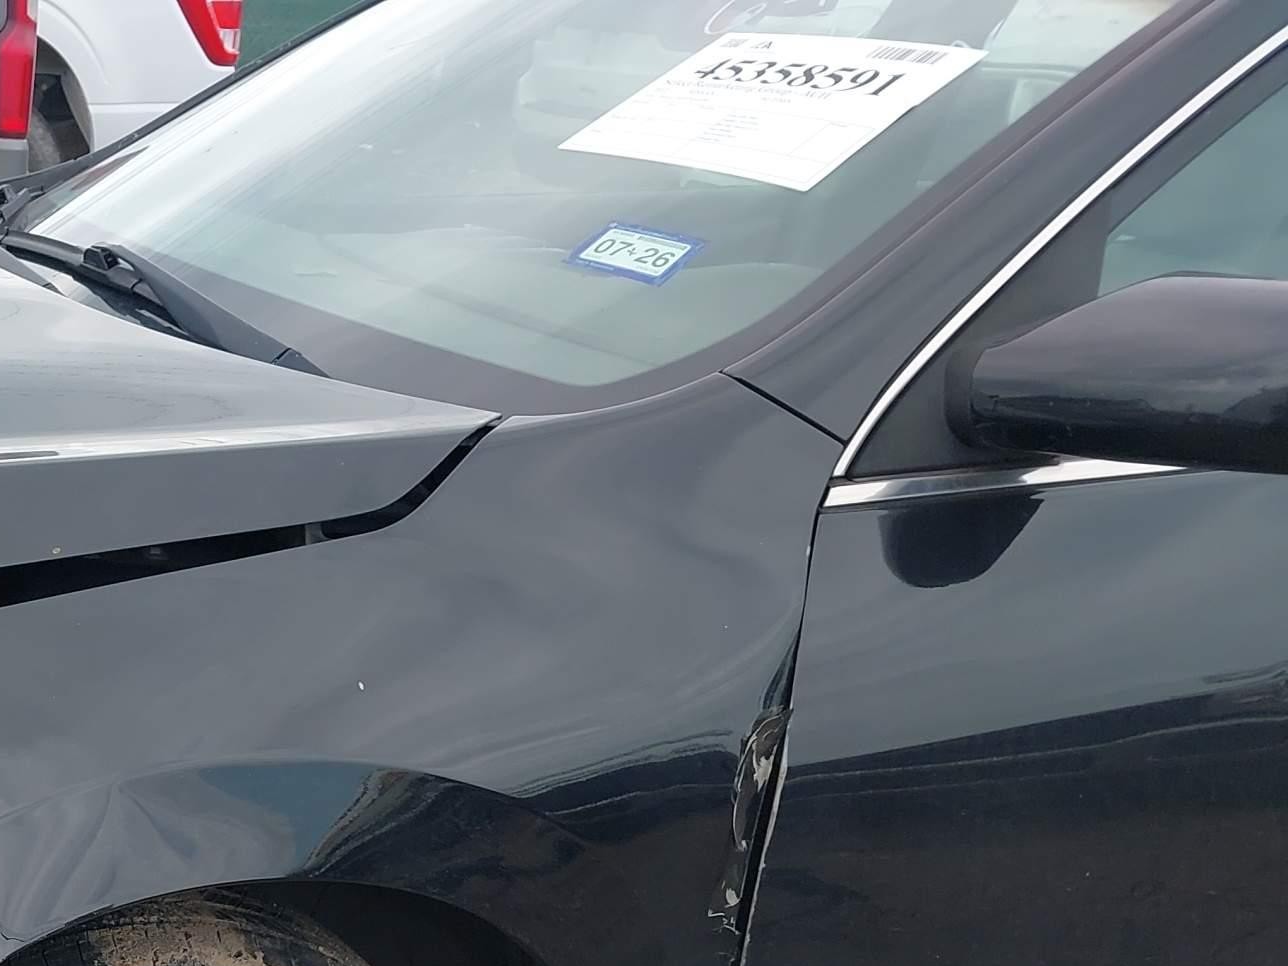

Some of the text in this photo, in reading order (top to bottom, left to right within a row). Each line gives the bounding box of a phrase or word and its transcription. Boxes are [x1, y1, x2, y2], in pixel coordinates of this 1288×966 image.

[694, 58, 906, 97] 45358591
[593, 238, 634, 257] 07
[633, 247, 676, 268] 26
